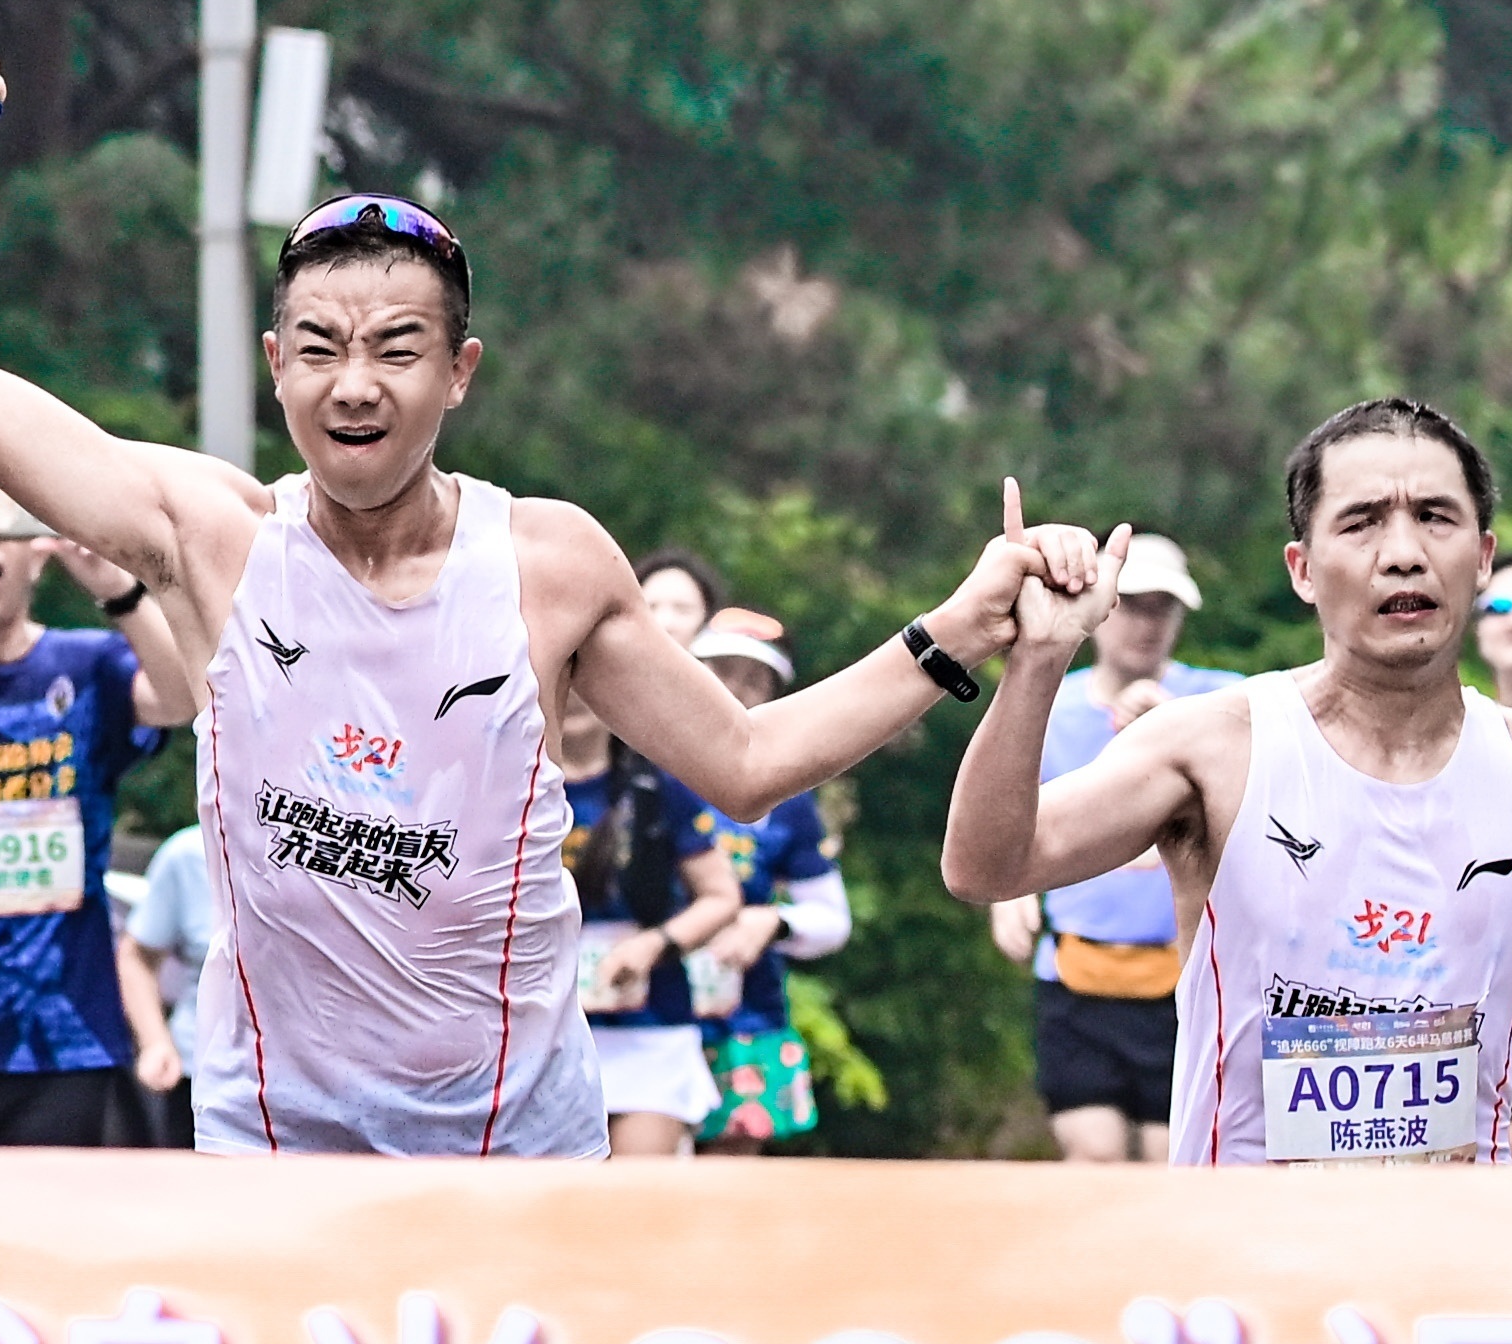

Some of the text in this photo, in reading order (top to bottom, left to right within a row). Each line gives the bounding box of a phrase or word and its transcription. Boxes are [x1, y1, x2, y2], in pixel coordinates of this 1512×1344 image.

[259, 791, 452, 871] 让跑起来的盲友
[276, 829, 423, 901] 先富起来
[1287, 1057, 1461, 1113] A0715
[1330, 1115, 1429, 1152] 陈燕波
